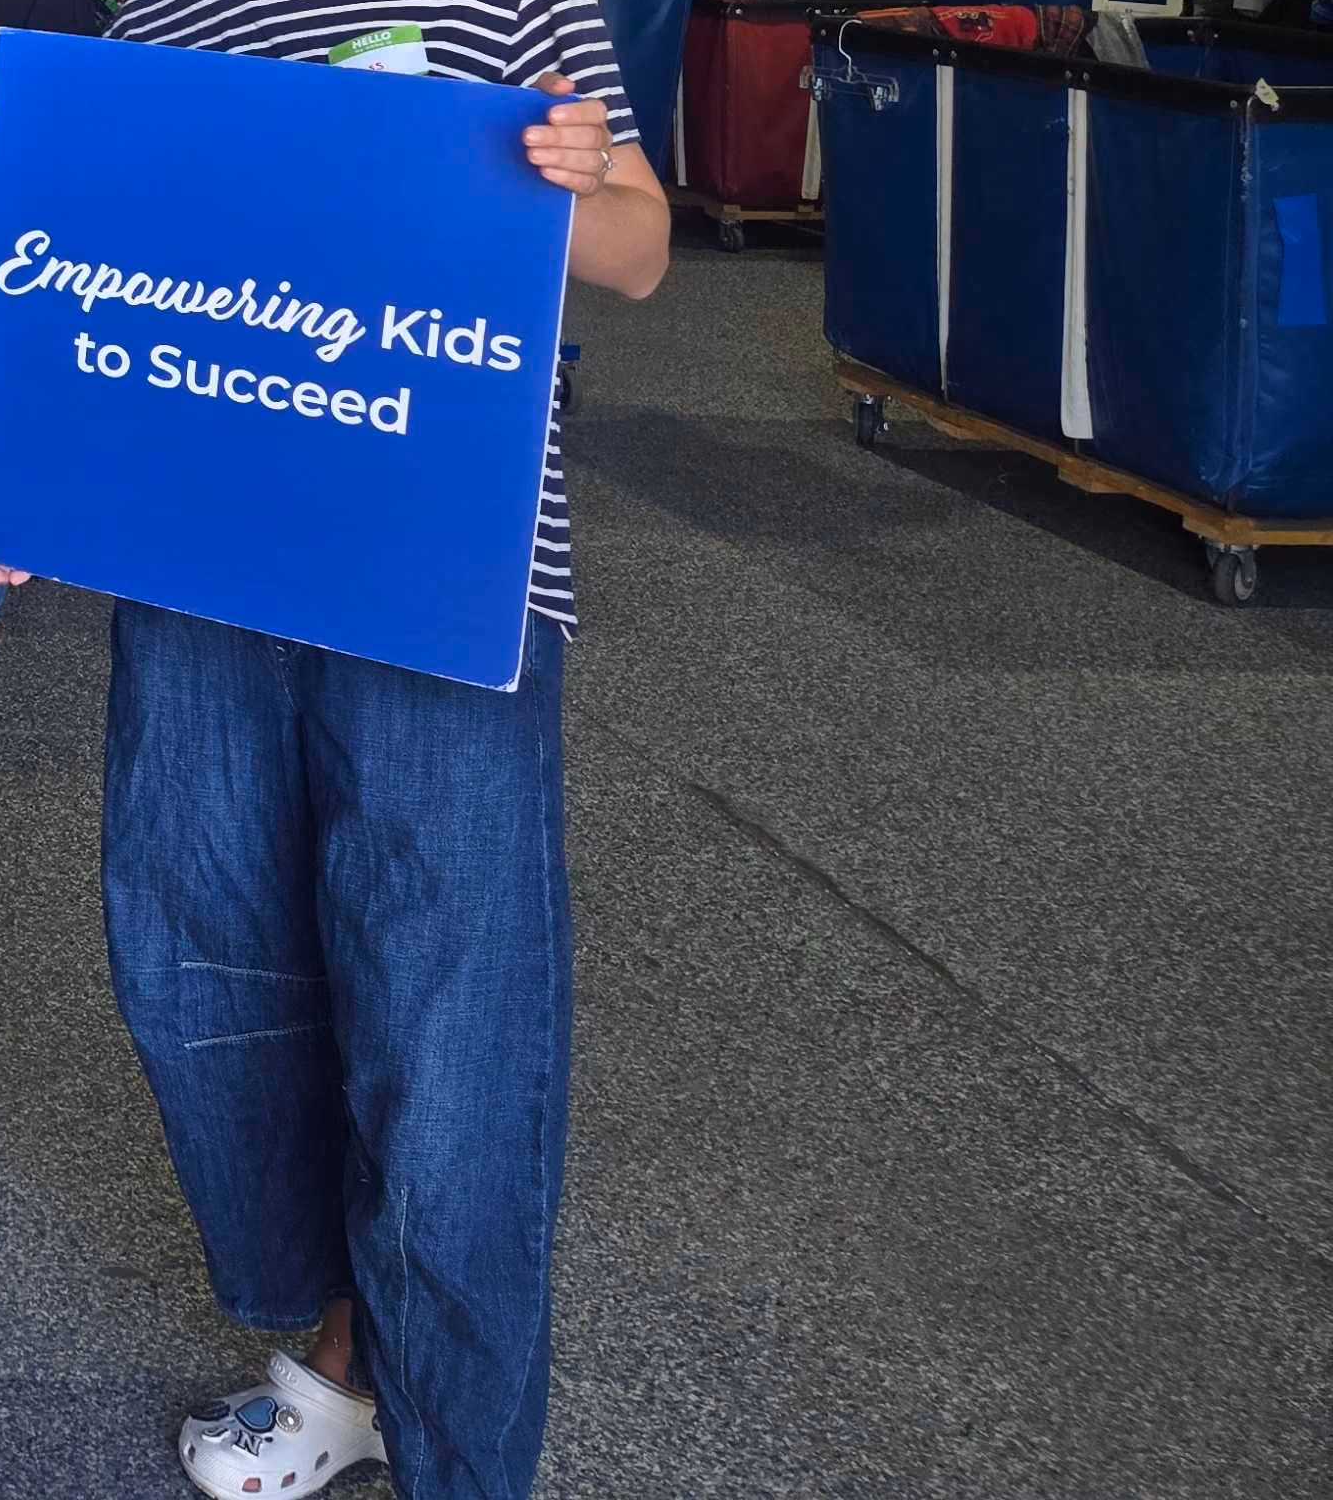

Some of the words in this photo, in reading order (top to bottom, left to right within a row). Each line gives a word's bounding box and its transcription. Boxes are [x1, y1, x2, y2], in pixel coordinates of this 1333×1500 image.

[352, 31, 392, 50] HELLO
[381, 305, 522, 372] Kids
[74, 331, 132, 378] to
[147, 343, 411, 436] Succeed
